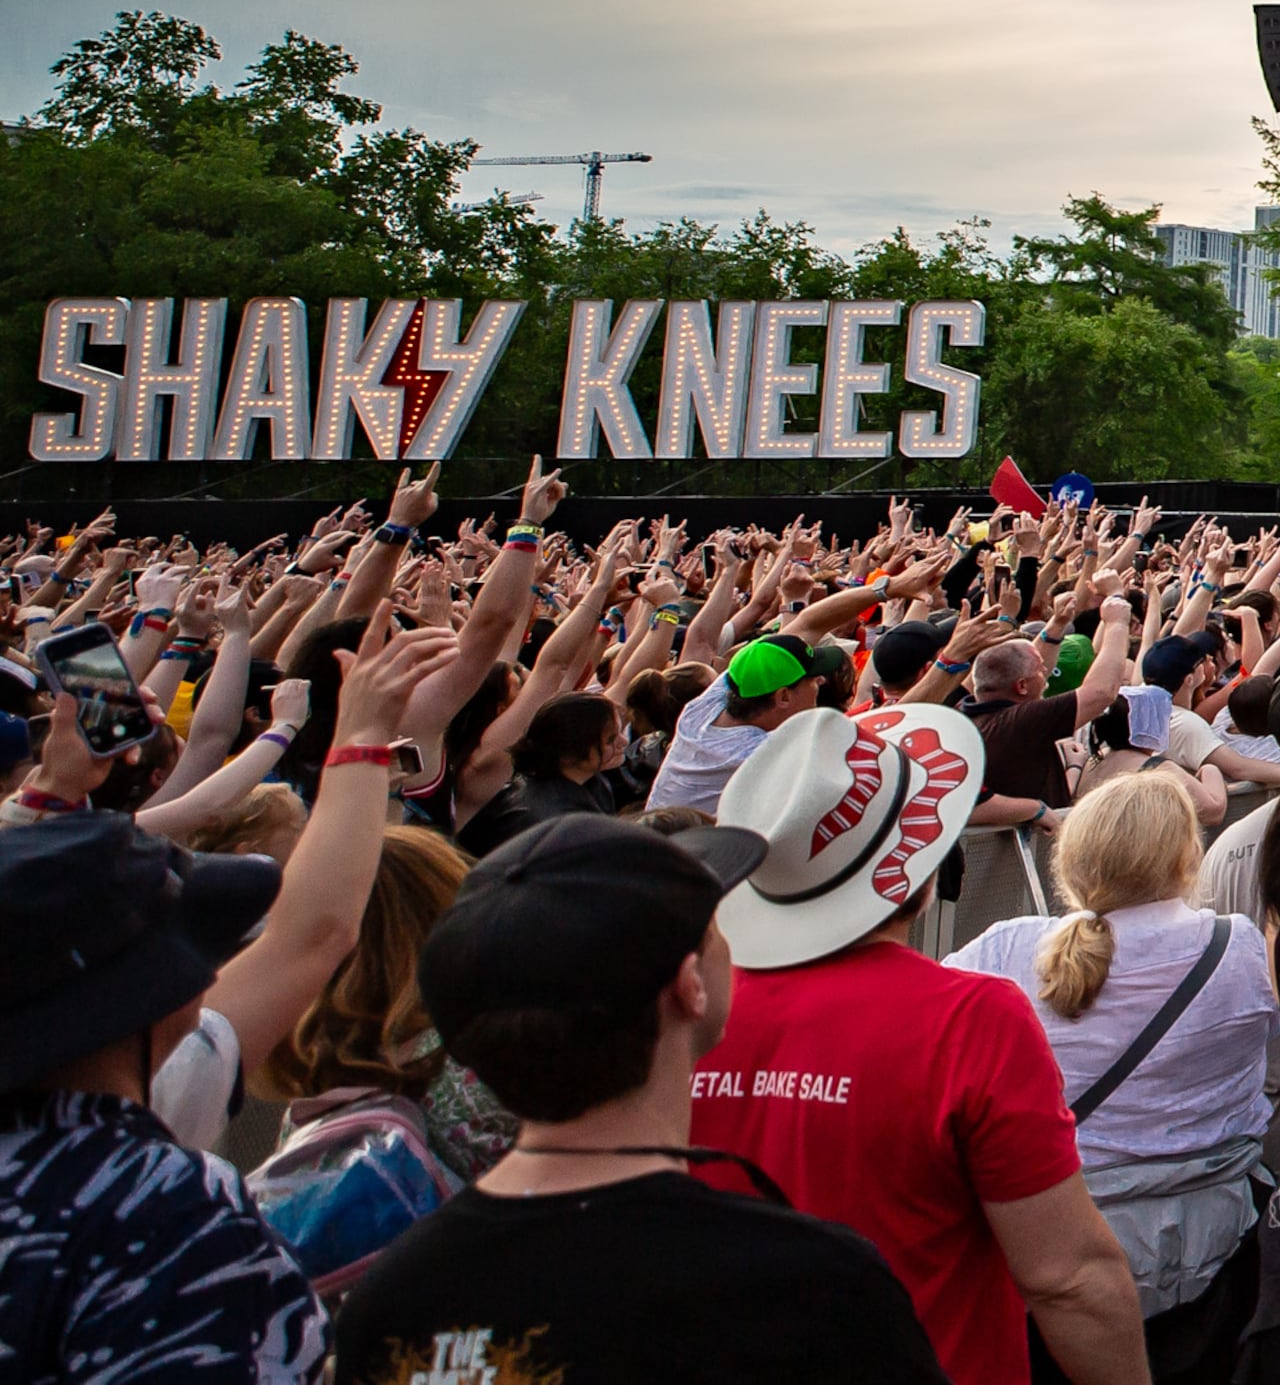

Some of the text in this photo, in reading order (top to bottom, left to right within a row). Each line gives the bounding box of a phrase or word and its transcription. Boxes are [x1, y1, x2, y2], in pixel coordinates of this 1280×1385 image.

[28, 297, 986, 462] SHAKY KNEES
[688, 1070, 852, 1105] ETAL BAKE SALE
[432, 1327, 494, 1369] THE
